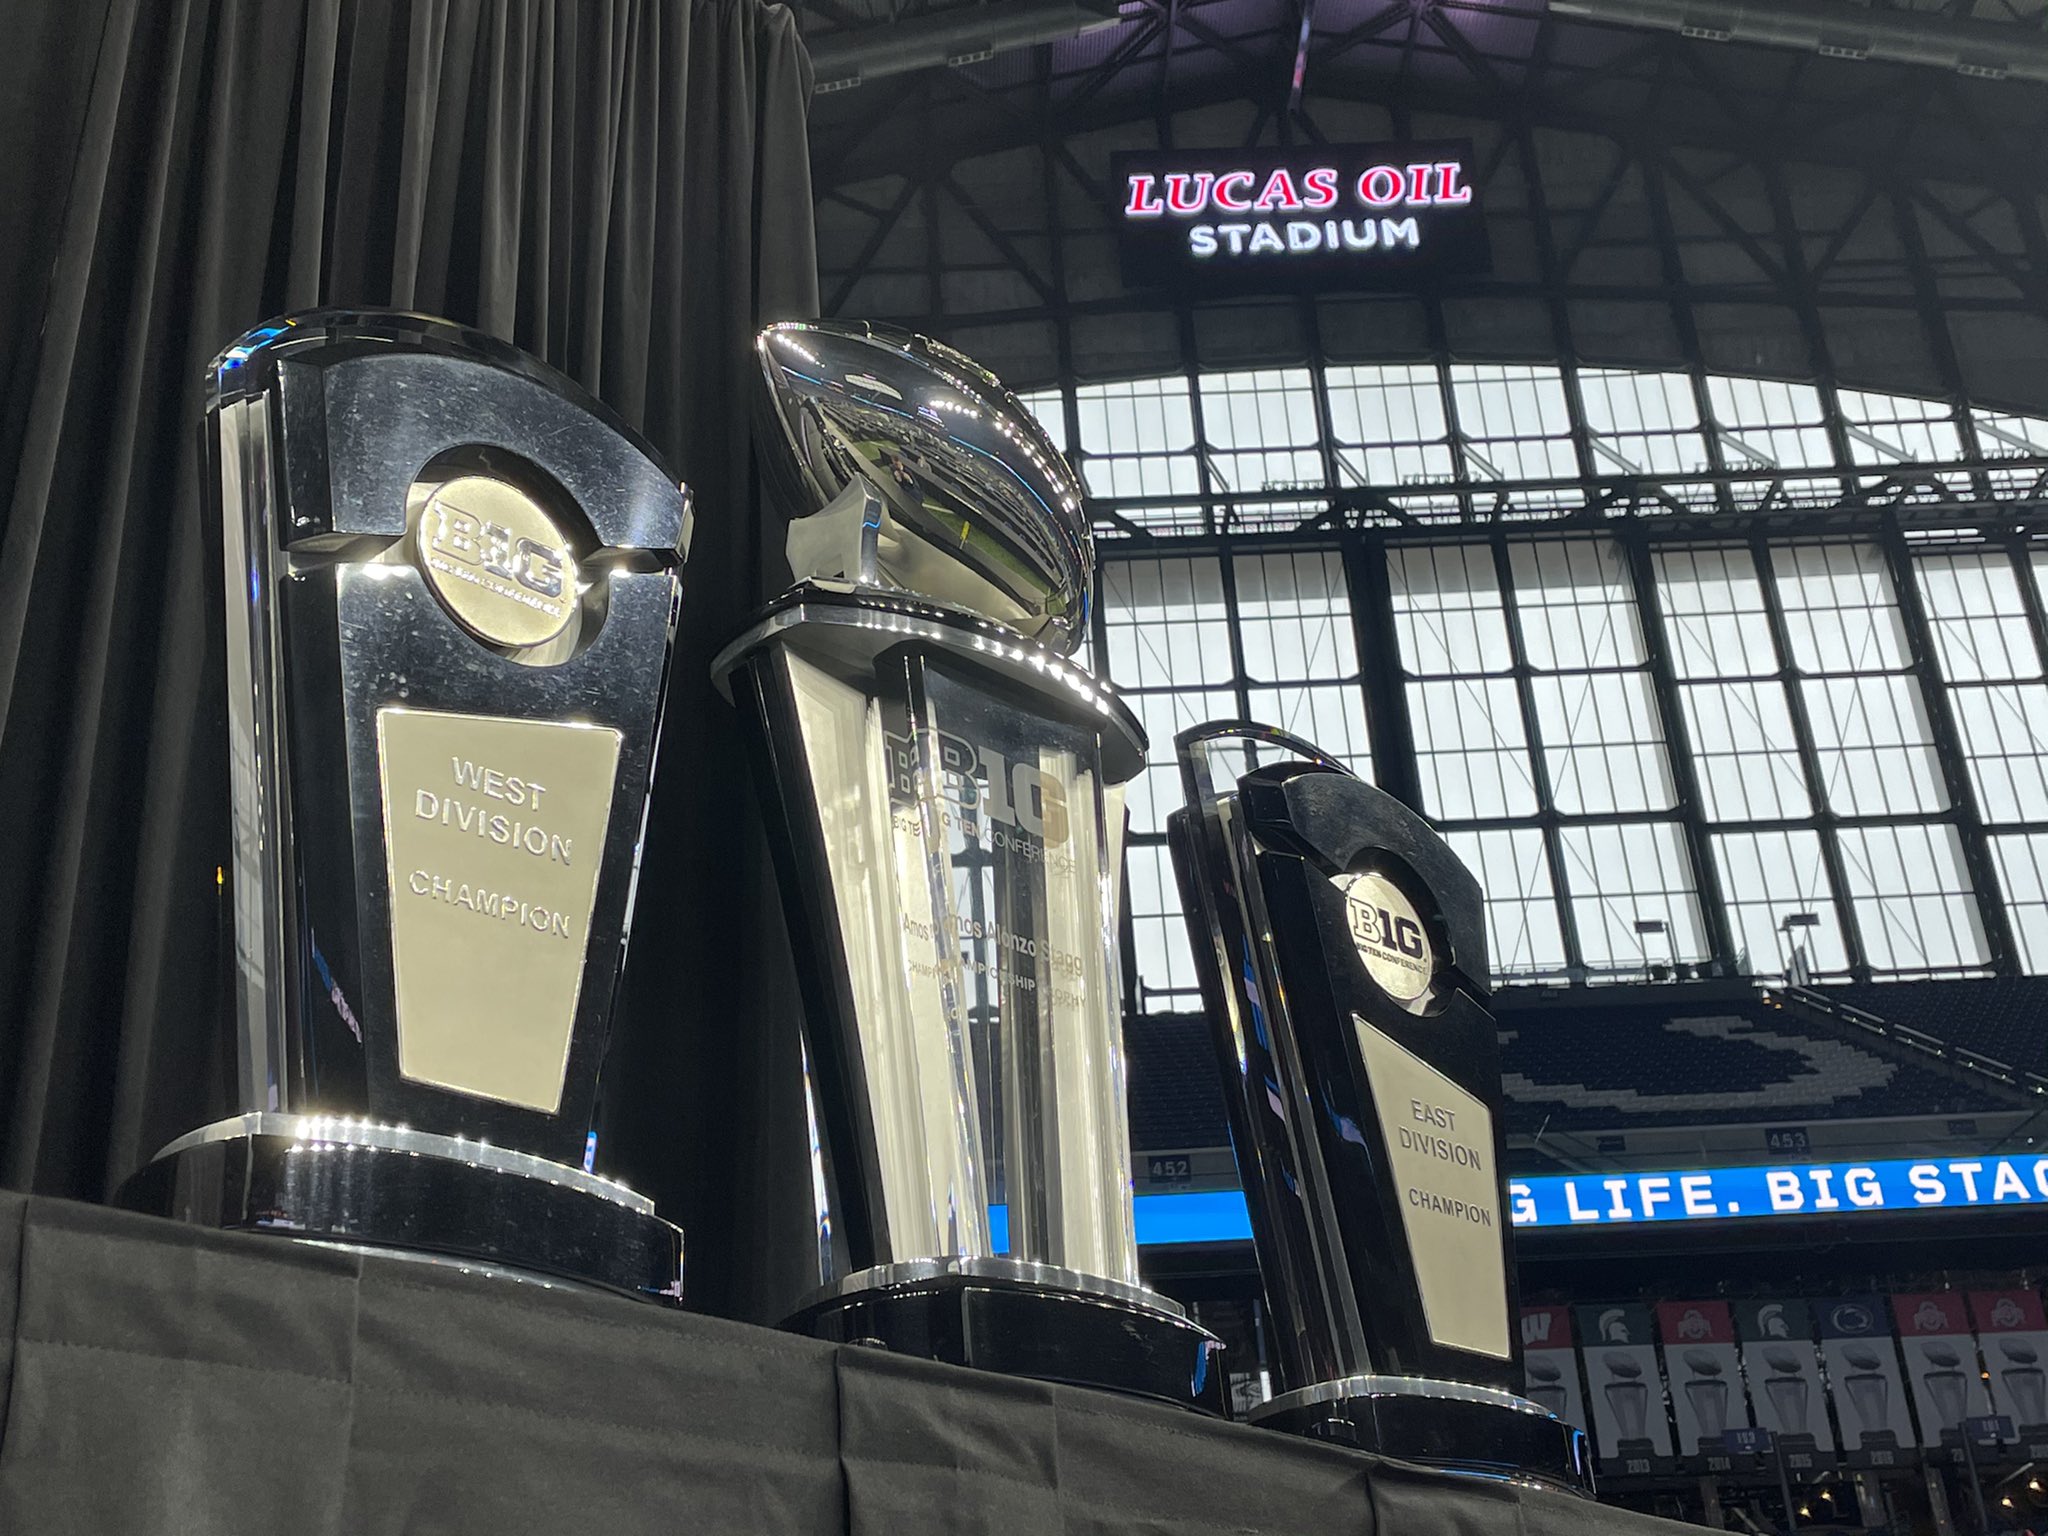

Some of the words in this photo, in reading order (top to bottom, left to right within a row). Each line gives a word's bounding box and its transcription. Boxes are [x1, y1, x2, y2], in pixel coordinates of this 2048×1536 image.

[1125, 168, 1340, 217] LUCAS
[1357, 162, 1473, 206] OIL
[1189, 216, 1421, 256] STADIUM
[452, 756, 547, 812] WEST
[415, 788, 573, 866] DIVISION
[409, 870, 571, 938] CHAMPION
[1411, 1097, 1455, 1132] EAST
[1398, 1125, 1482, 1171] DIVISION
[1769, 1130, 1806, 1149] 453
[1152, 1160, 1188, 1177] 452
[1409, 1187, 1491, 1227] CHAMPION
[1564, 1175, 1740, 1222] LIFE.
[1765, 1167, 1884, 1211] BIG
